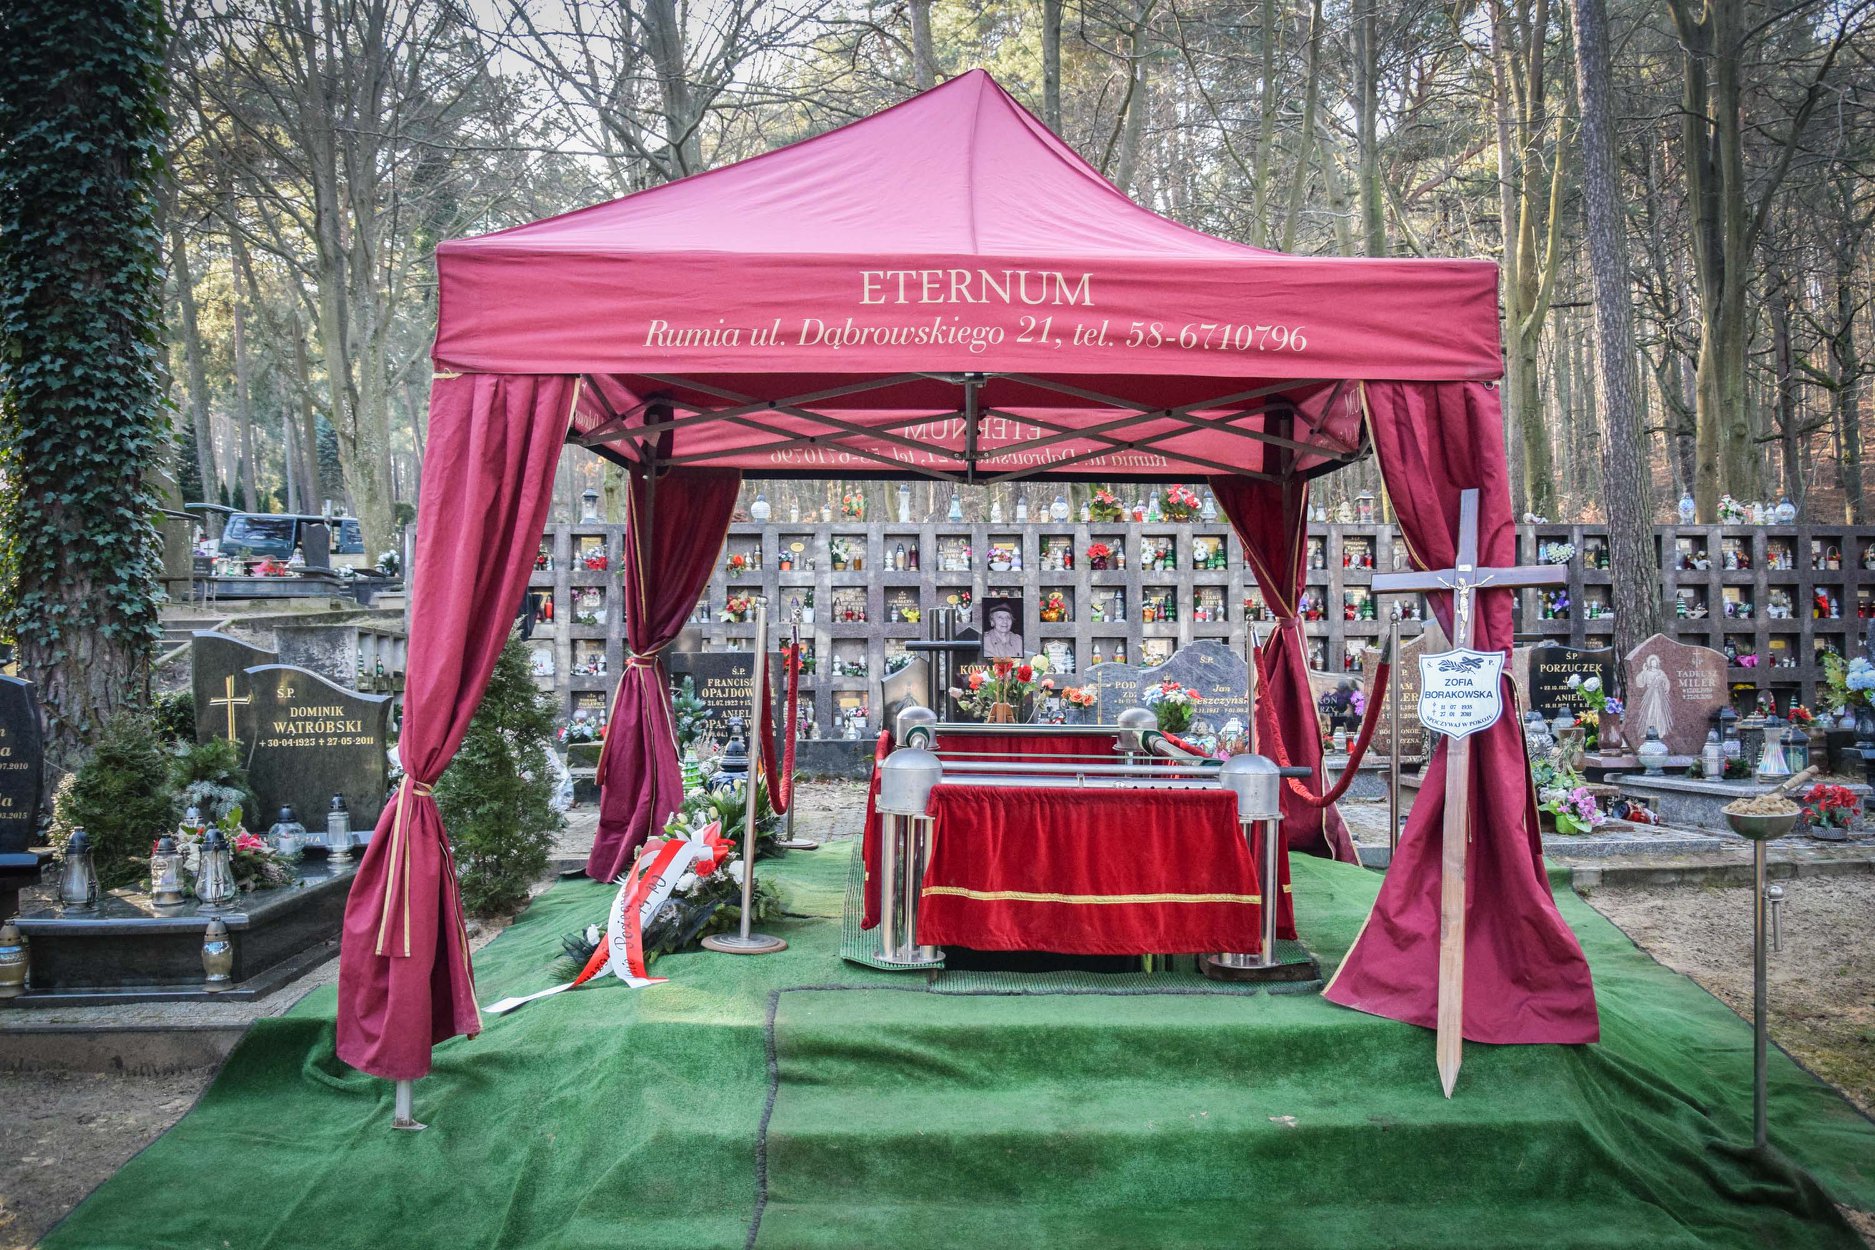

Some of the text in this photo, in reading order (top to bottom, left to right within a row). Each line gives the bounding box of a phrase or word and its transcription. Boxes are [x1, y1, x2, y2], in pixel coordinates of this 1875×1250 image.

[859, 268, 1095, 306] ETERNUM
[643, 315, 1307, 354] Rumia ul. Dąbrowskiego 21, tel. 58-6710796
[1540, 663, 1603, 673] PORZUCZEK
[1212, 684, 1231, 693] Jan
[1445, 679, 1473, 687] ZOFIA
[1678, 678, 1716, 687] MILER
[276, 686, 296, 699] Ś.P.
[1425, 690, 1493, 699] BORAKOWSKA
[290, 706, 345, 718] DOMINIK
[1426, 716, 1460, 728] SPOCZYWAJ
[1469, 713, 1494, 726] POKOJU
[273, 718, 362, 736] WĄTRÓBSKI
